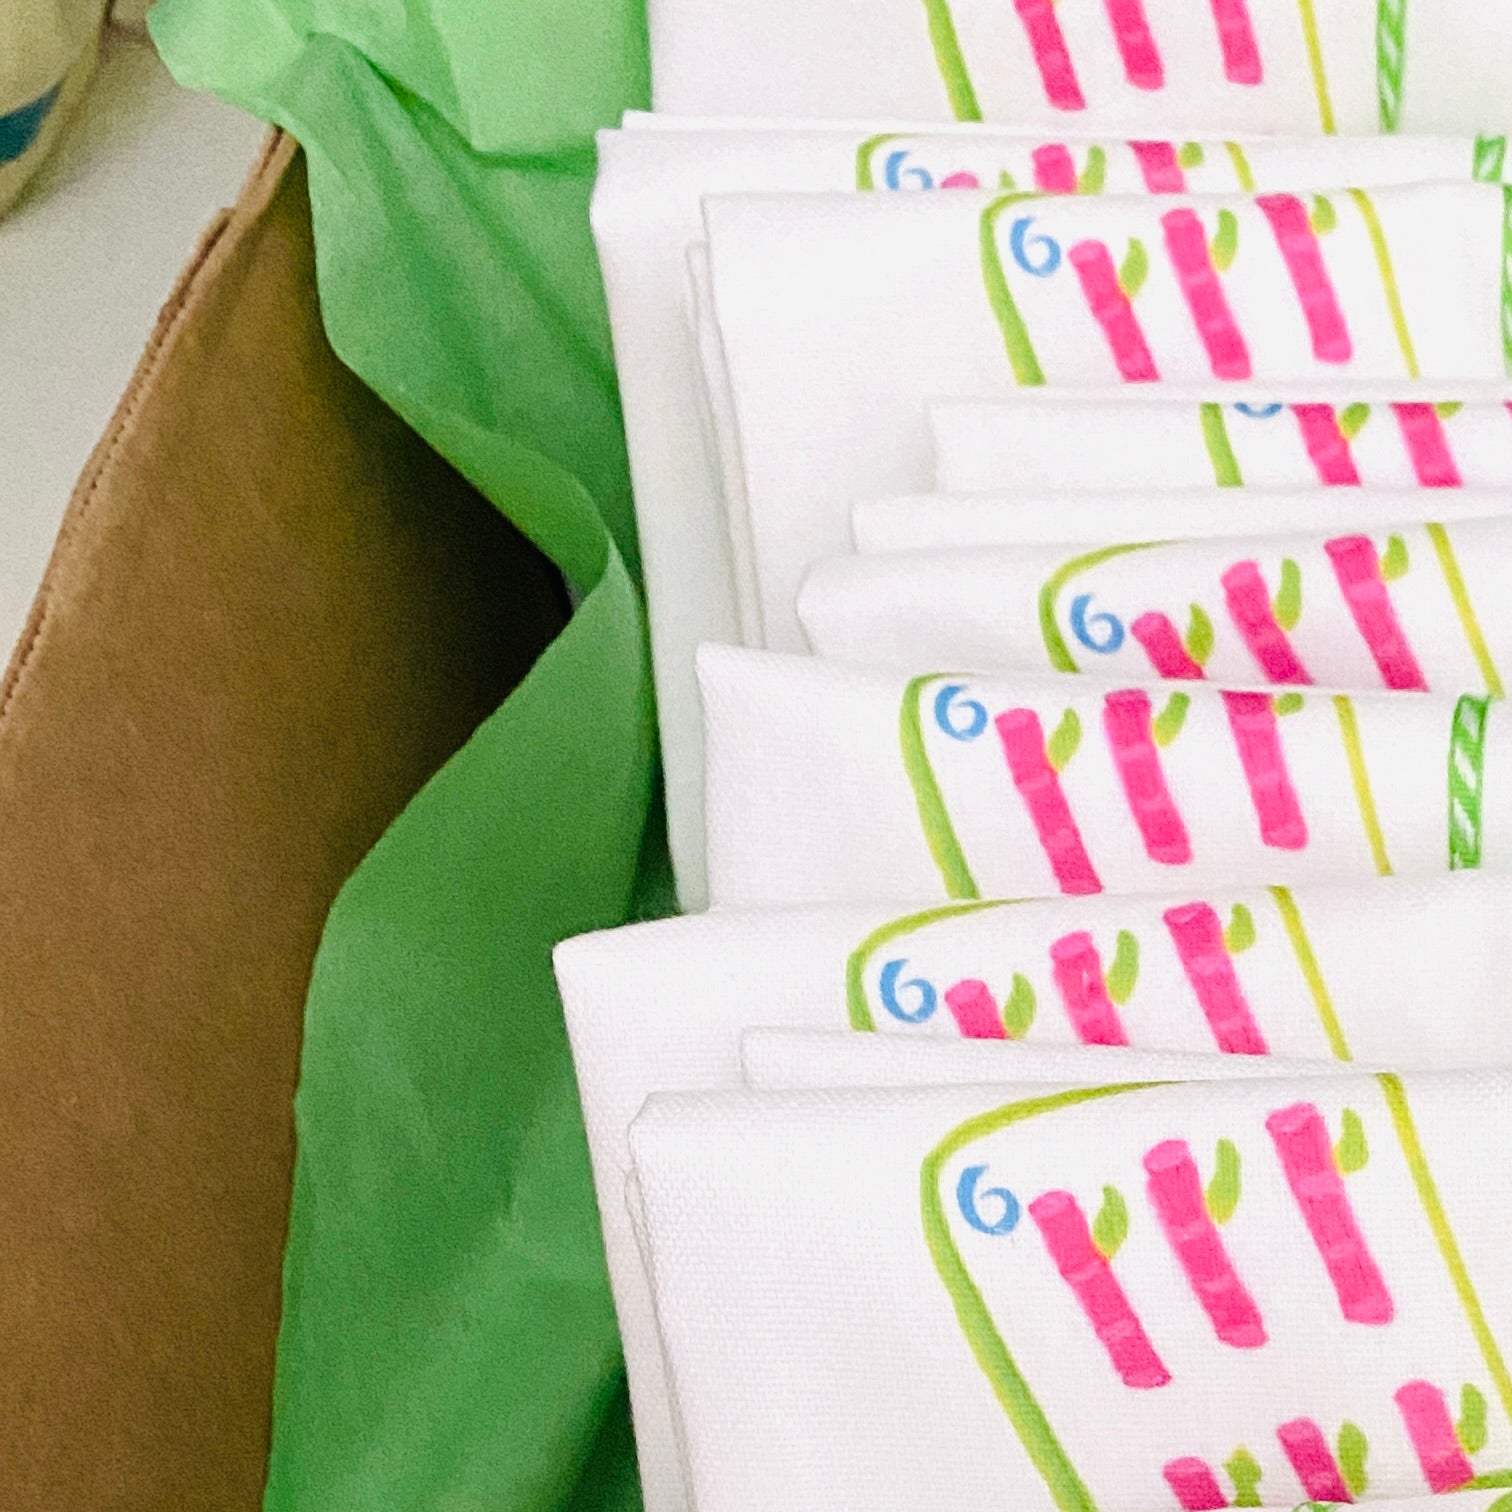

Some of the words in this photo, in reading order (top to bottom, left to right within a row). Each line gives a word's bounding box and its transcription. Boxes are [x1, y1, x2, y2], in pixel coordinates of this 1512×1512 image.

[1010, 216, 1062, 277] 6
[1069, 594, 1125, 654] 6
[934, 684, 988, 741] 6
[879, 959, 938, 1024] 6
[956, 1164, 1021, 1236] 6
